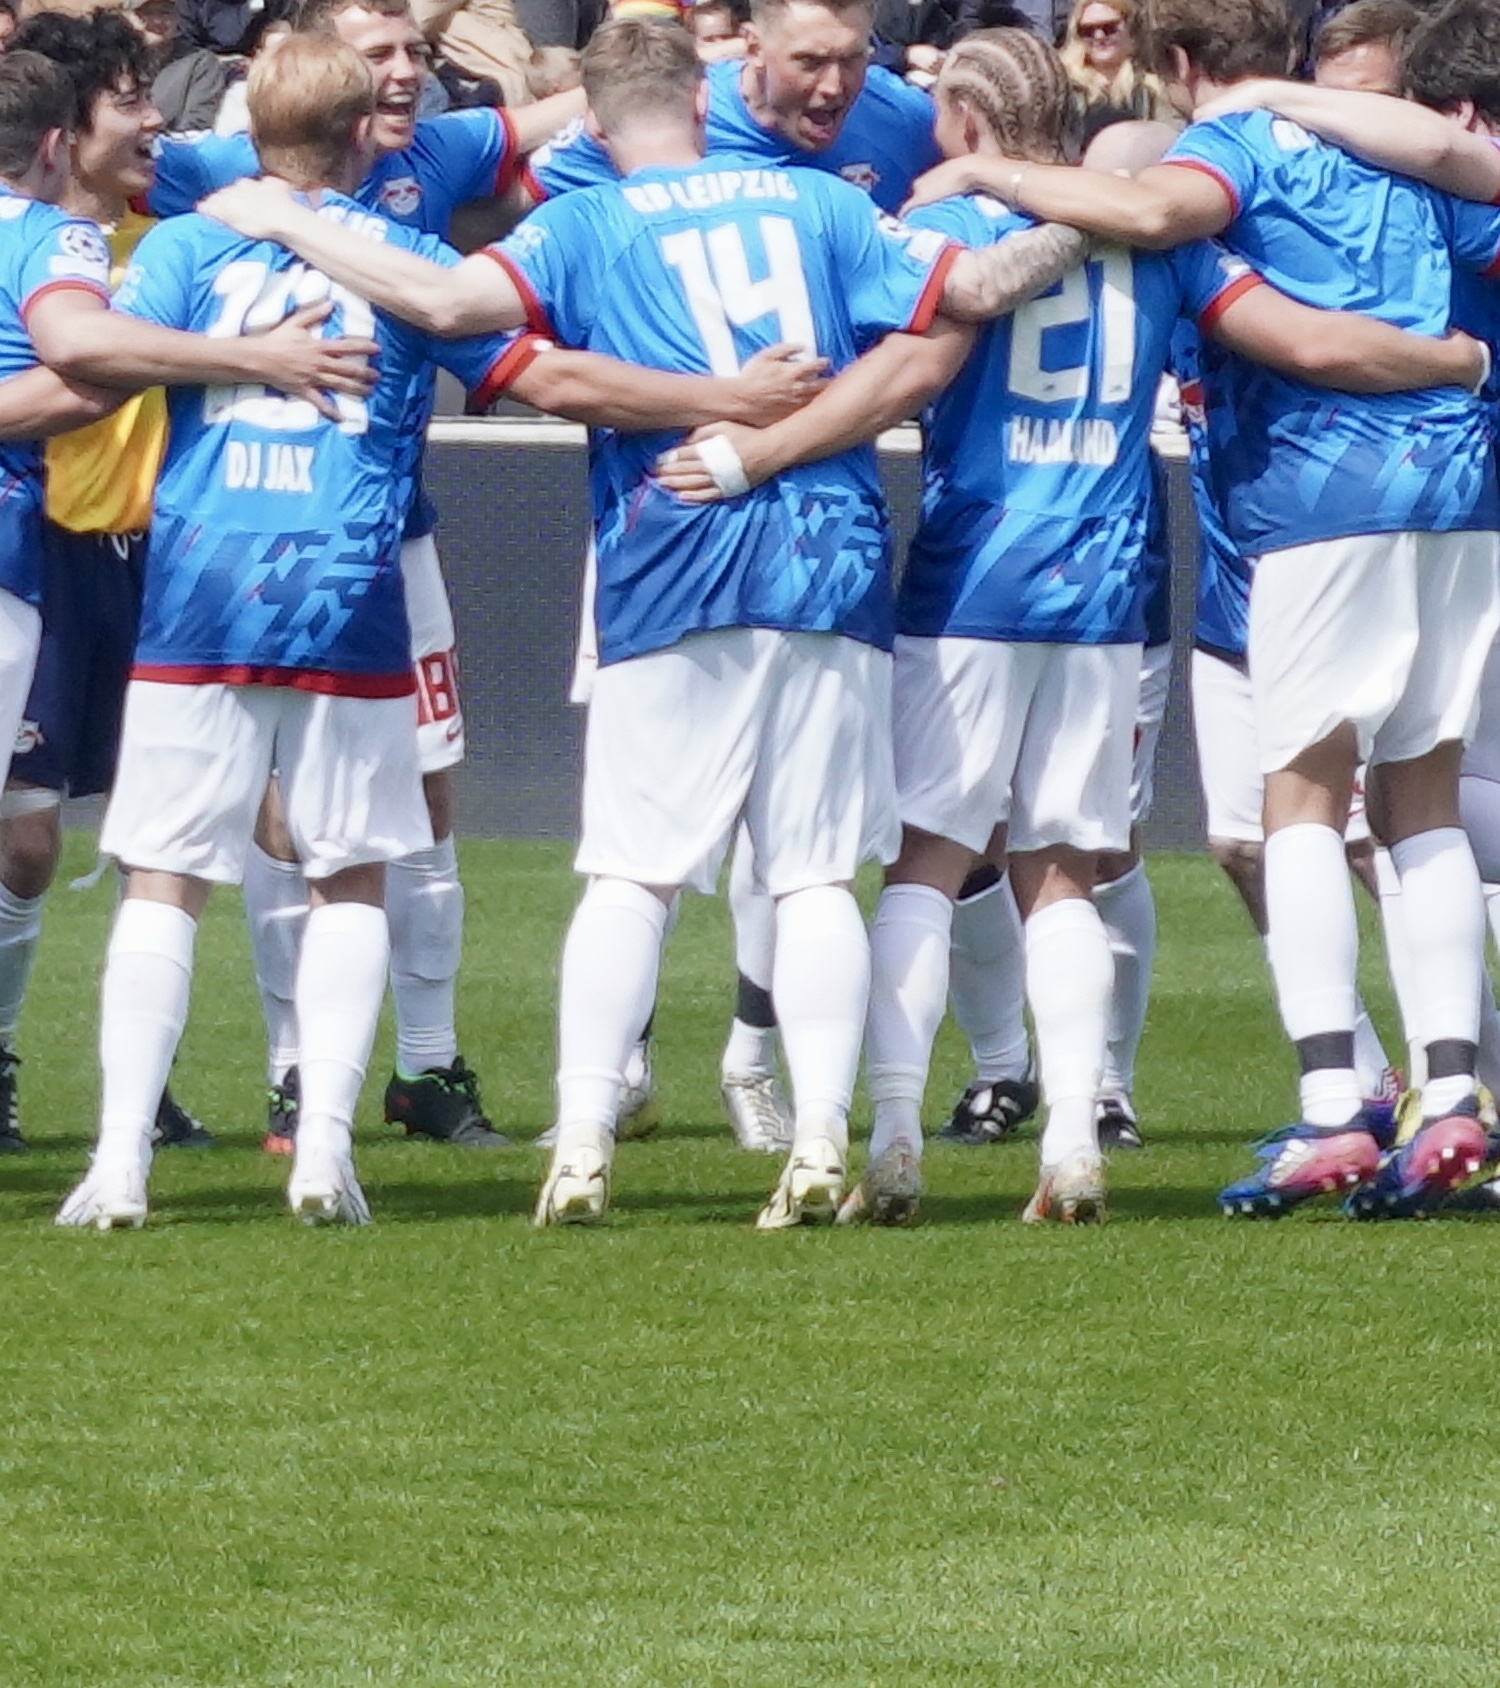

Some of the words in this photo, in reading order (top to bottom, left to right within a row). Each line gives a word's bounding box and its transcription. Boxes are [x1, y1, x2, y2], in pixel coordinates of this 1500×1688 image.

[660, 216, 818, 377] 14
[1008, 247, 1136, 402] 21
[225, 440, 262, 490] DJ
[263, 442, 316, 493] JAX
